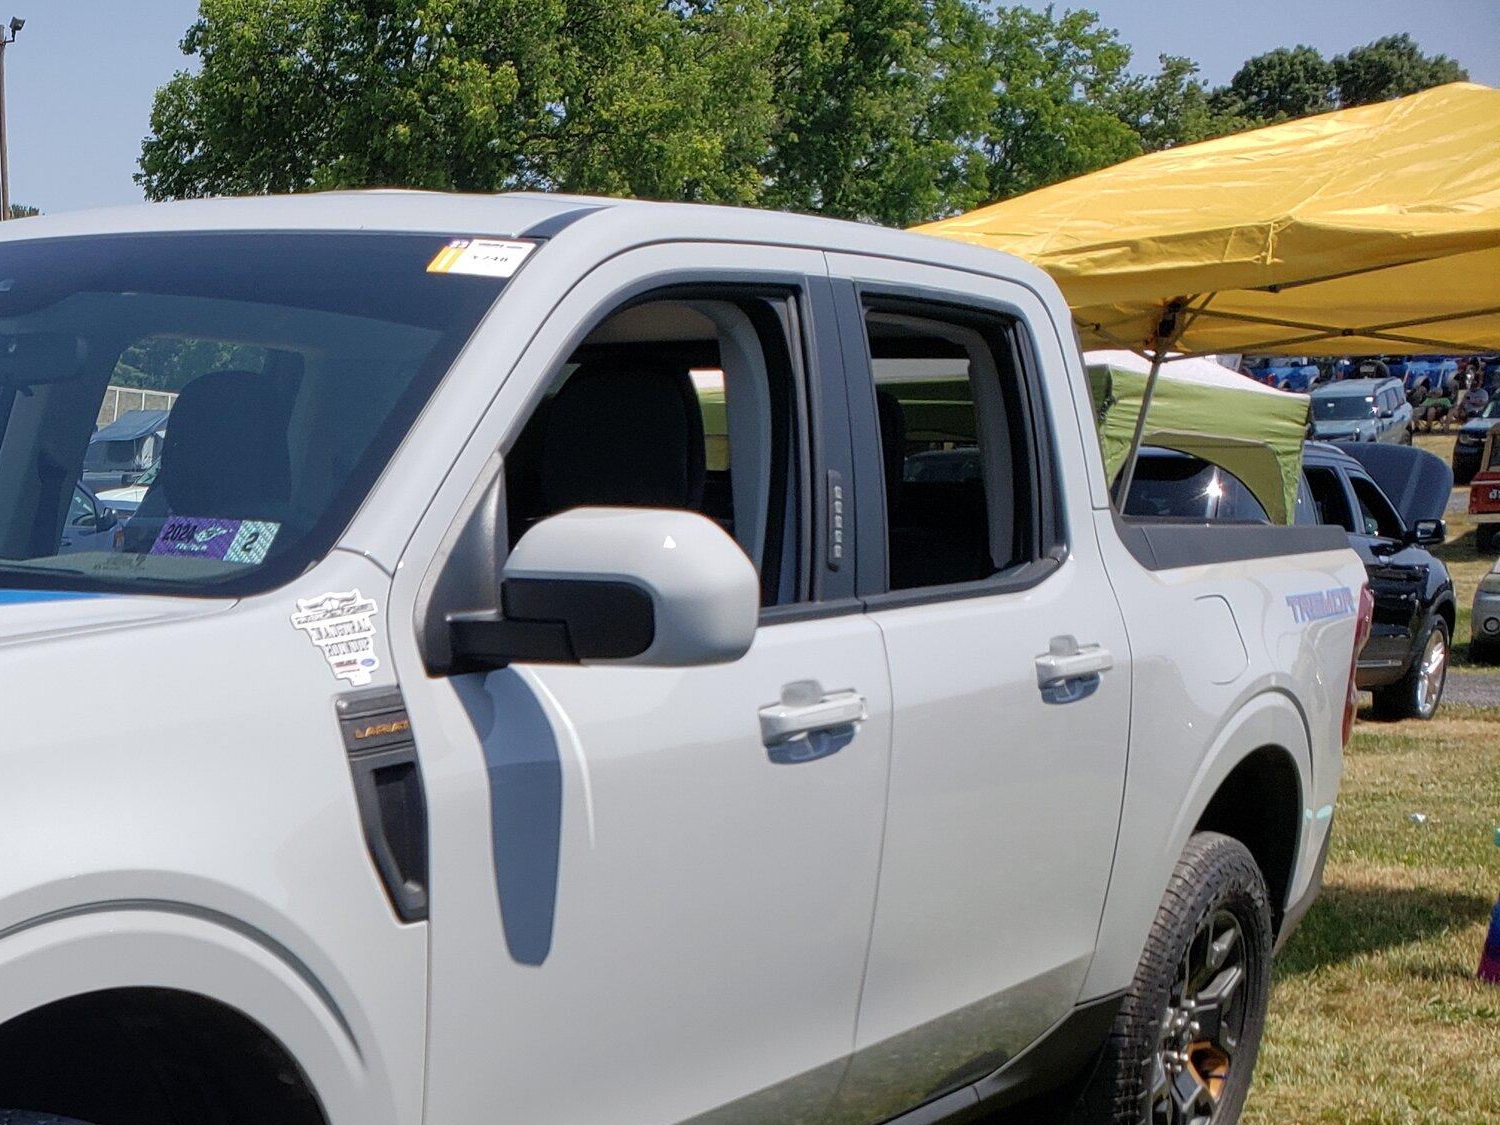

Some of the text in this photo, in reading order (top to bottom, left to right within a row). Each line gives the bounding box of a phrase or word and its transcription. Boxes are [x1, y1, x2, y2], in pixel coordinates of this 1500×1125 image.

[163, 522, 260, 553] 2024 2
[1284, 586, 1356, 624] TREMOR
